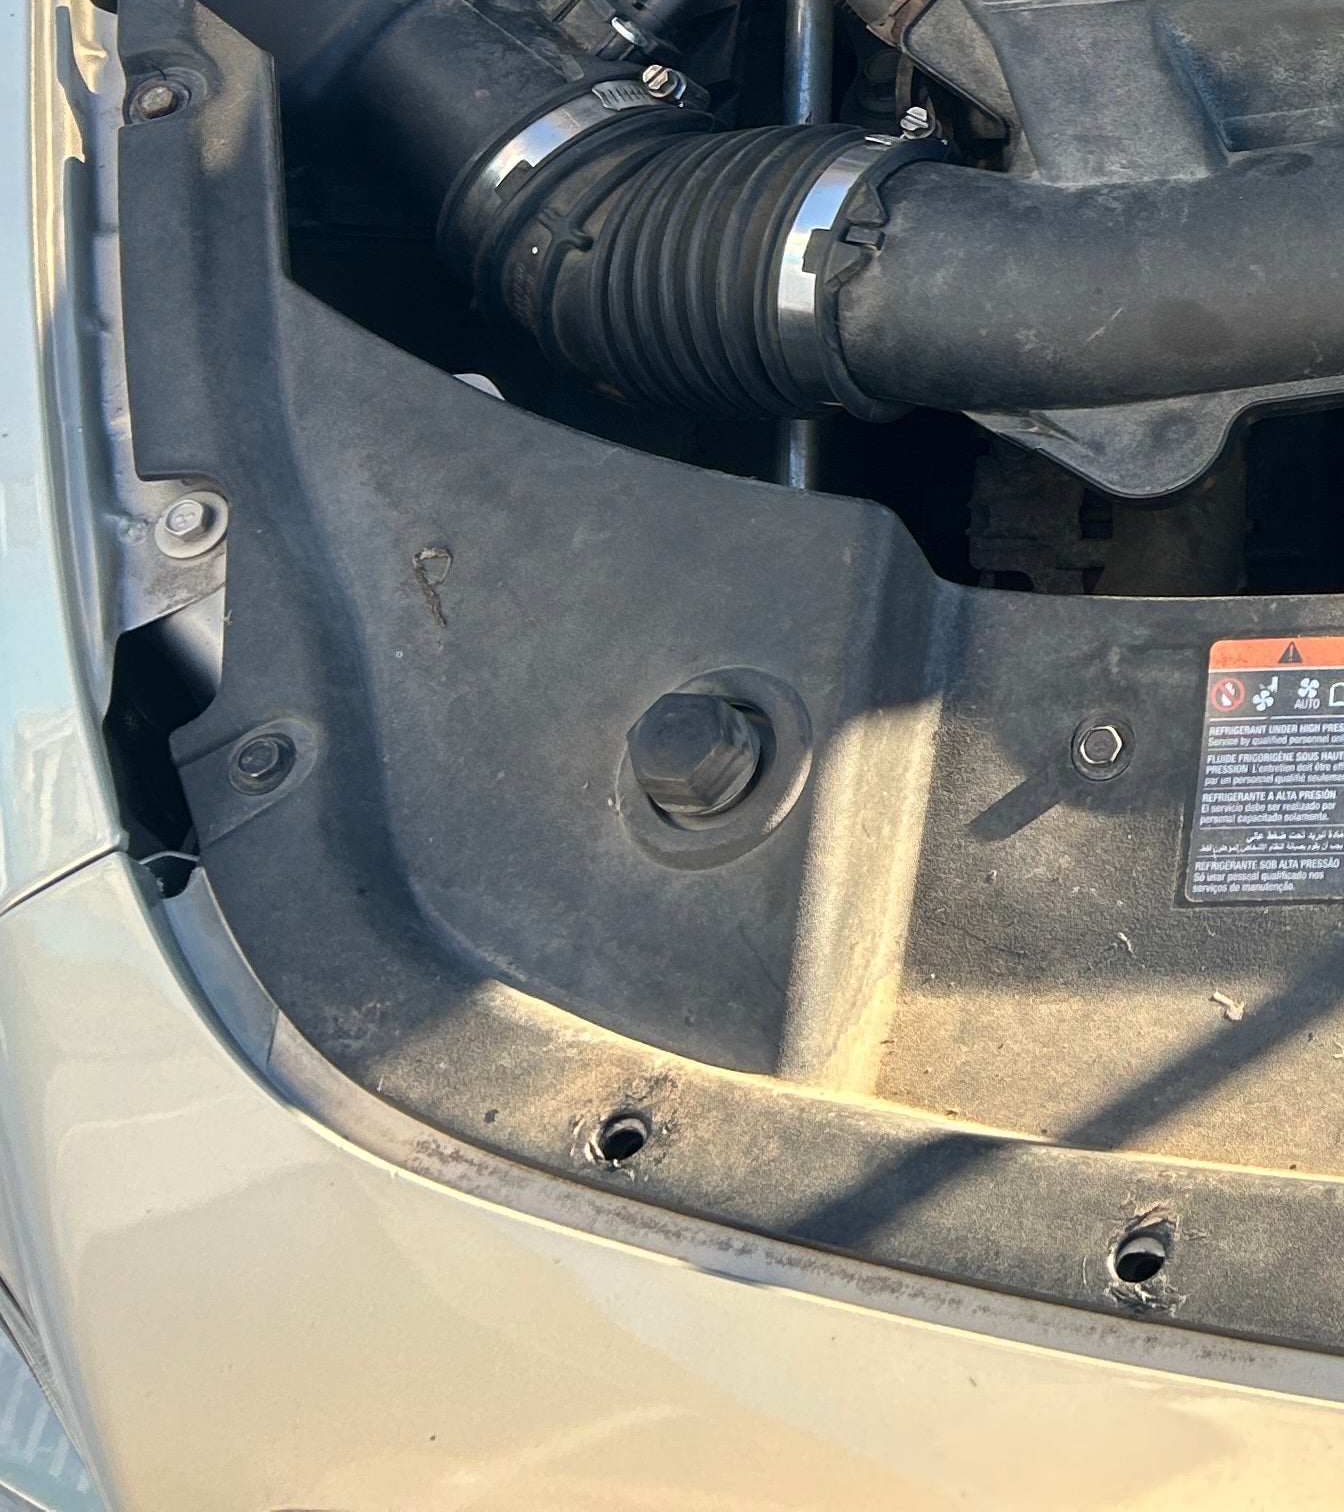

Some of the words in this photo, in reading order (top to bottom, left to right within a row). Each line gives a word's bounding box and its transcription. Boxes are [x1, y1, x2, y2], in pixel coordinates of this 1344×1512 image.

[1294, 698, 1321, 710] AUTO
[1209, 725, 1266, 736] REFRIGERANT
[1268, 724, 1297, 733] UNDER
[1299, 723, 1320, 732] HIGH
